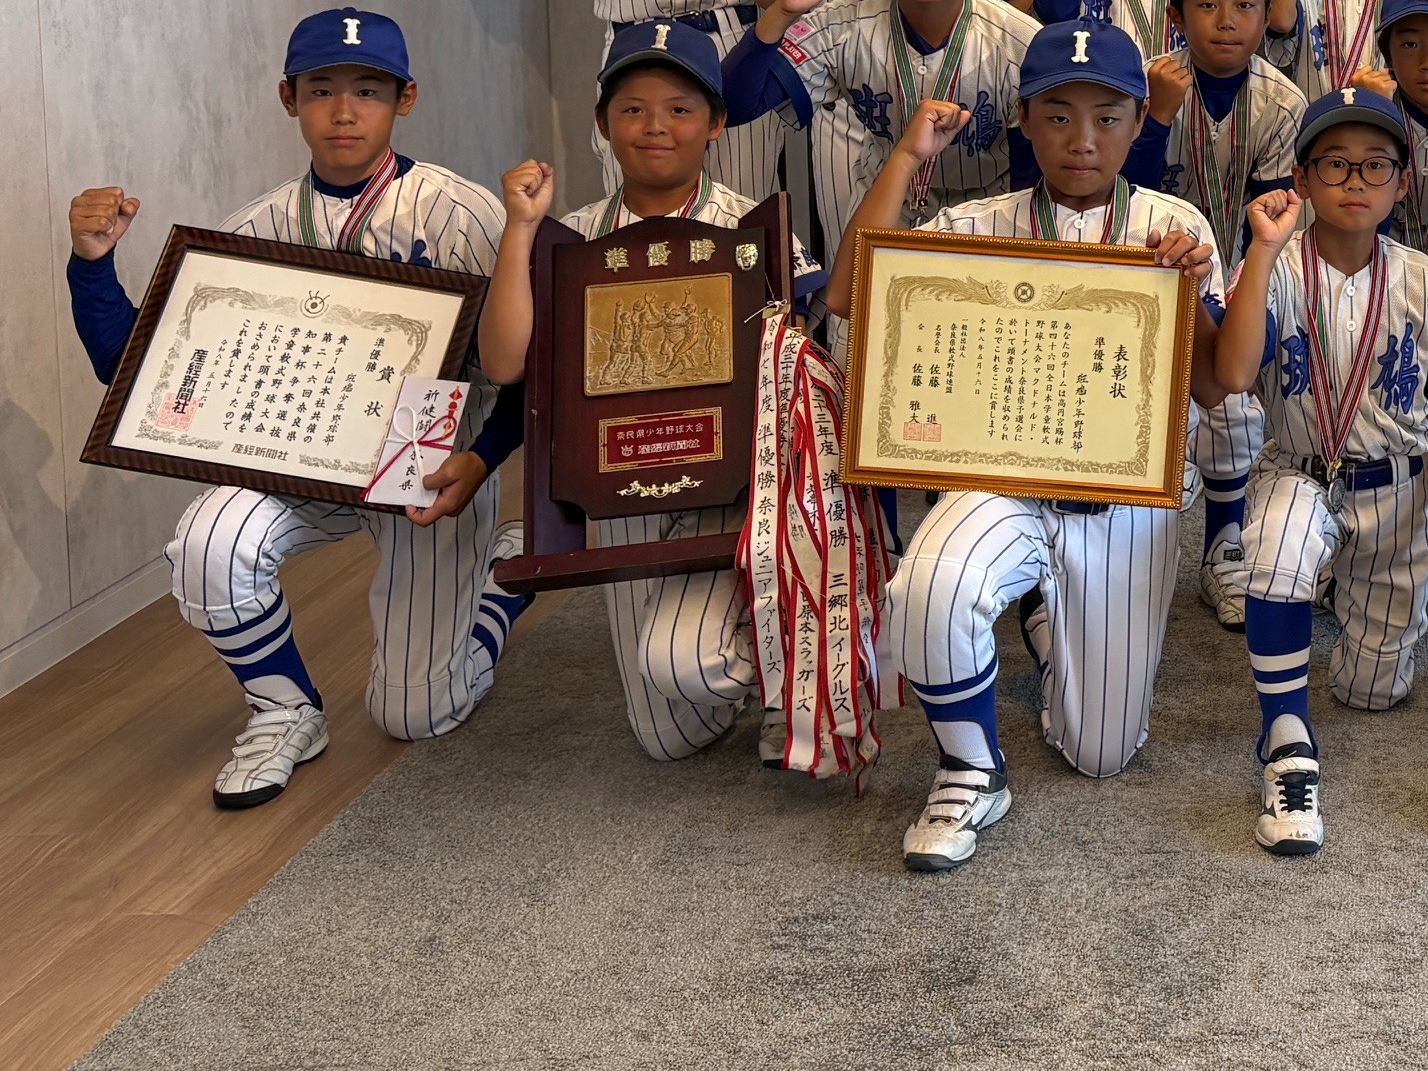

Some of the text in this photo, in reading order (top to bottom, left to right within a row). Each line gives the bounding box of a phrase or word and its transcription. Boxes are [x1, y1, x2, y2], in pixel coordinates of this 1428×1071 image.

[342, 18, 361, 45] I
[655, 23, 671, 49] I
[1072, 30, 1090, 63] I
[1340, 87, 1356, 105] I
[604, 238, 716, 273] 準優勝
[219, 318, 251, 390] これを賞します
[238, 324, 284, 433] において頭書の成績を
[254, 326, 301, 433] 学童軟式野球大会
[269, 329, 317, 438] 知事杯争奪選抜
[286, 332, 333, 442] 第二十六回奈良県
[303, 334, 350, 444] 貴チームは本社共催の
[364, 365, 395, 418] 賞状
[365, 337, 385, 372] 準優勝
[974, 318, 986, 395] 令和八年五月十六日
[987, 317, 1004, 438] たのでこれをここに賞します
[1001, 318, 1018, 441] 於いて頭書の成績を収められ
[1014, 319, 1030, 442] トーナメント奈良県予選会に
[1041, 320, 1059, 445] 第四十六回全日本学童軟式
[1054, 322, 1072, 445] あなたのチームは高円宮賜杯
[1092, 336, 1106, 373] 準優勝
[1109, 344, 1130, 399] 表彰状
[617, 422, 704, 441] 奈良県少年野球大会
[822, 469, 850, 549] 準優勝
[828, 572, 851, 713] 三郷北イーグルス
